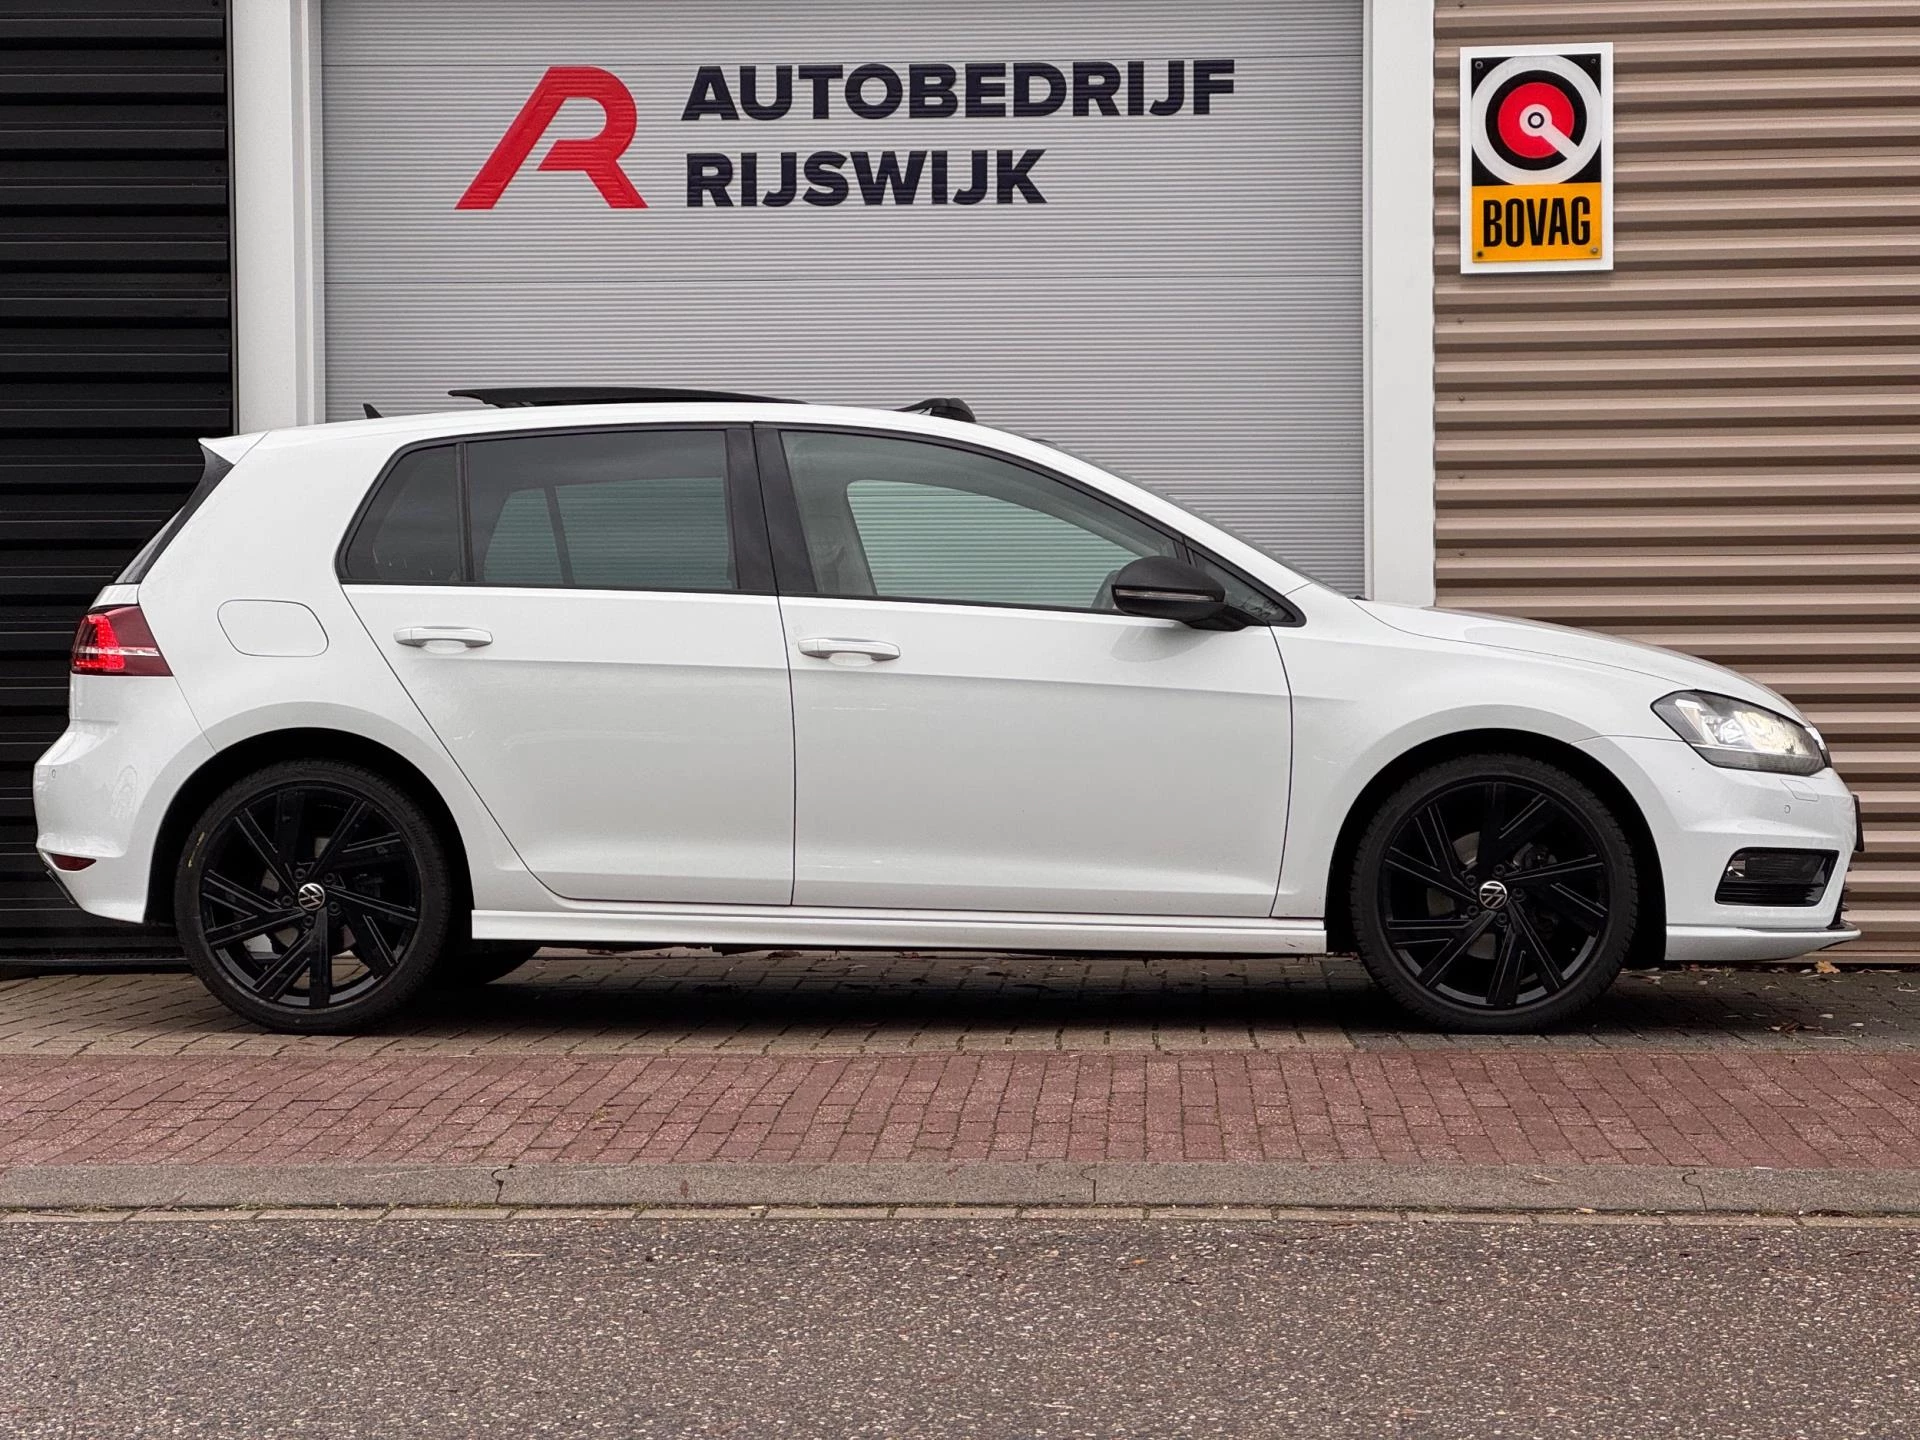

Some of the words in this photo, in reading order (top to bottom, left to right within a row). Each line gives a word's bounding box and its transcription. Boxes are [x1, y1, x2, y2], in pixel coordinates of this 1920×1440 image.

[681, 59, 1235, 121] AUTOBEDRIJF
[685, 149, 1048, 208] RIJSWIJK
[1483, 196, 1591, 248] BOVAG
